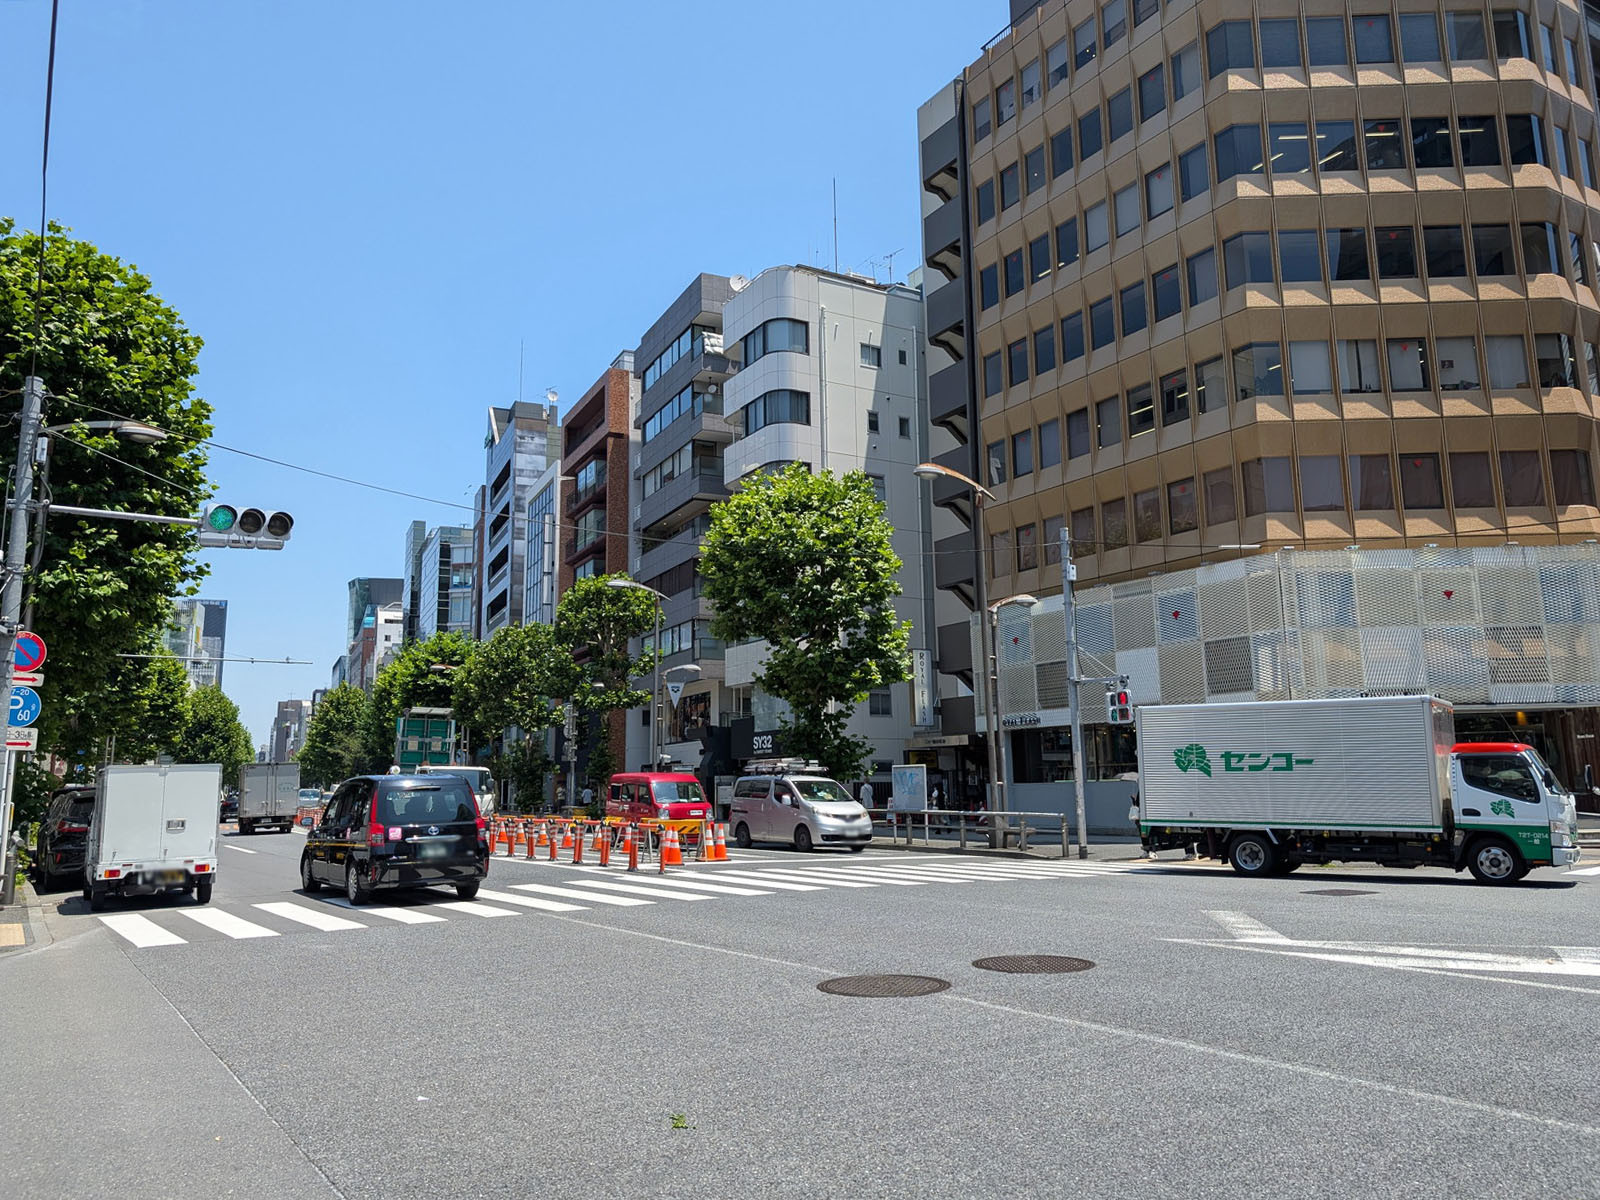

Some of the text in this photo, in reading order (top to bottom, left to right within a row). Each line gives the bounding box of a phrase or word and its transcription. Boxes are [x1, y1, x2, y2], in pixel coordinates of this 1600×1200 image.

[17, 709, 30, 722] 60
[753, 734, 773, 750] SY32
[1220, 751, 1315, 772] センコー
